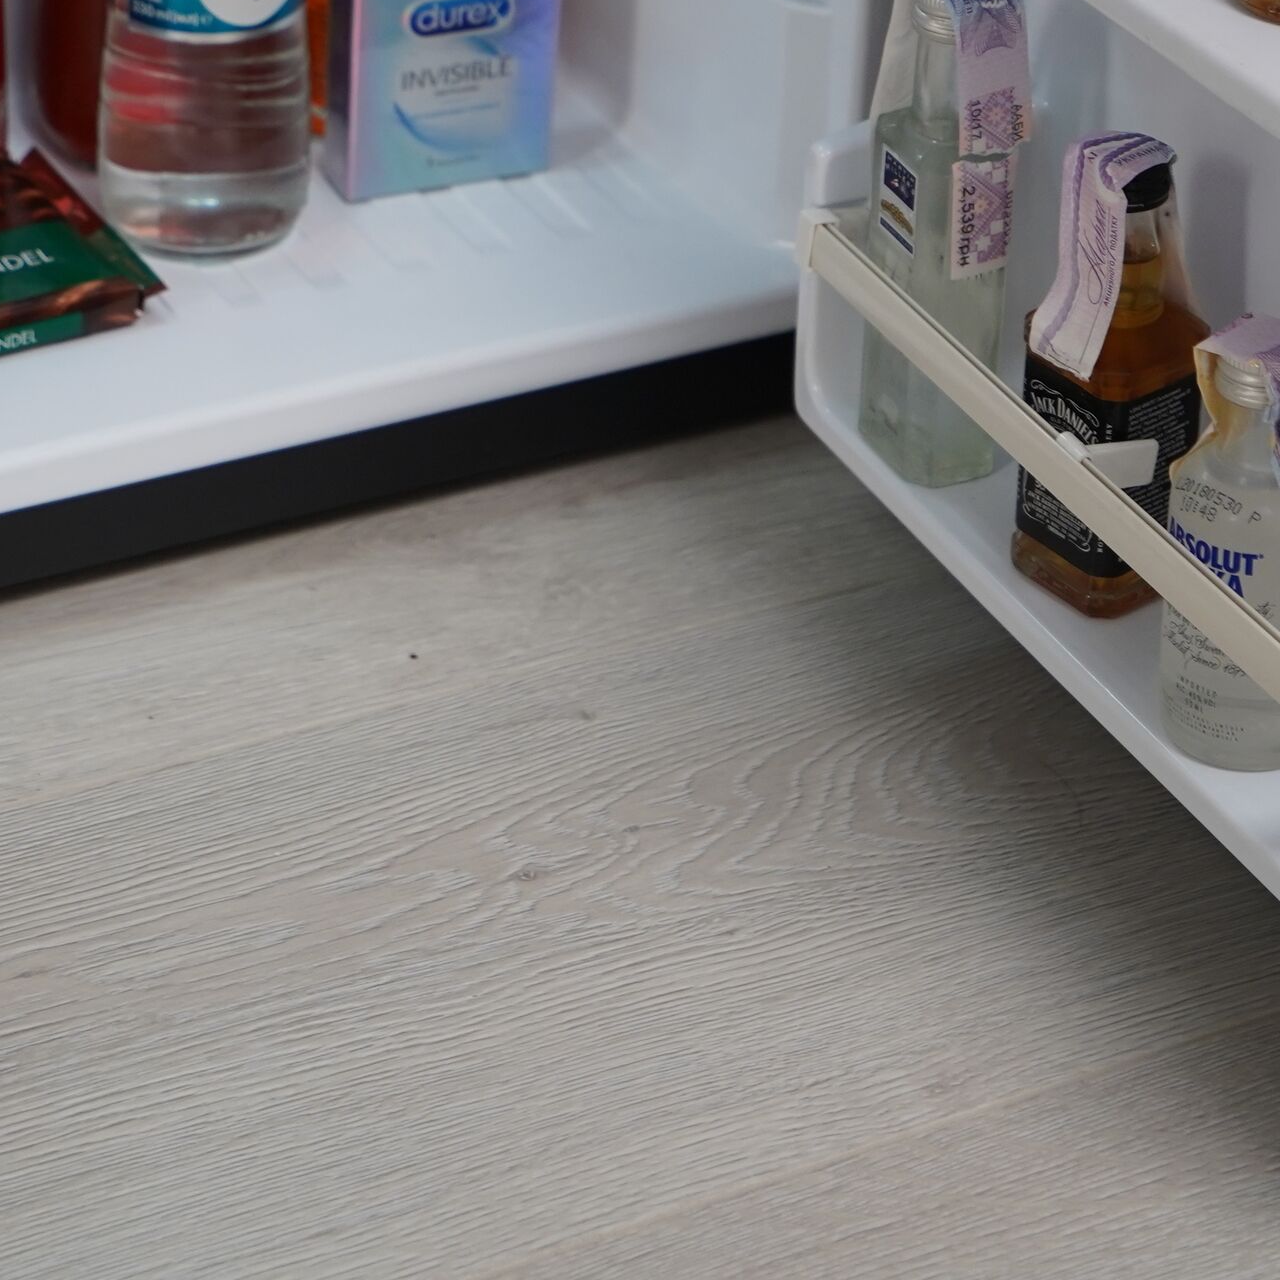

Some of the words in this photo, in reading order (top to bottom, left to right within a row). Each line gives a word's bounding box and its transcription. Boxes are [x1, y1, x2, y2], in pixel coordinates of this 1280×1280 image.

[417, 0, 504, 32] durex
[400, 55, 512, 92] INVISIBLE
[968, 99, 984, 141] 10/17
[960, 184, 976, 236] 2,539
[958, 236, 974, 268] грн
[1077, 199, 1108, 306] Марка
[1109, 215, 1119, 252] ПОДАТКУ
[1169, 515, 1259, 577] ABSOLUT
